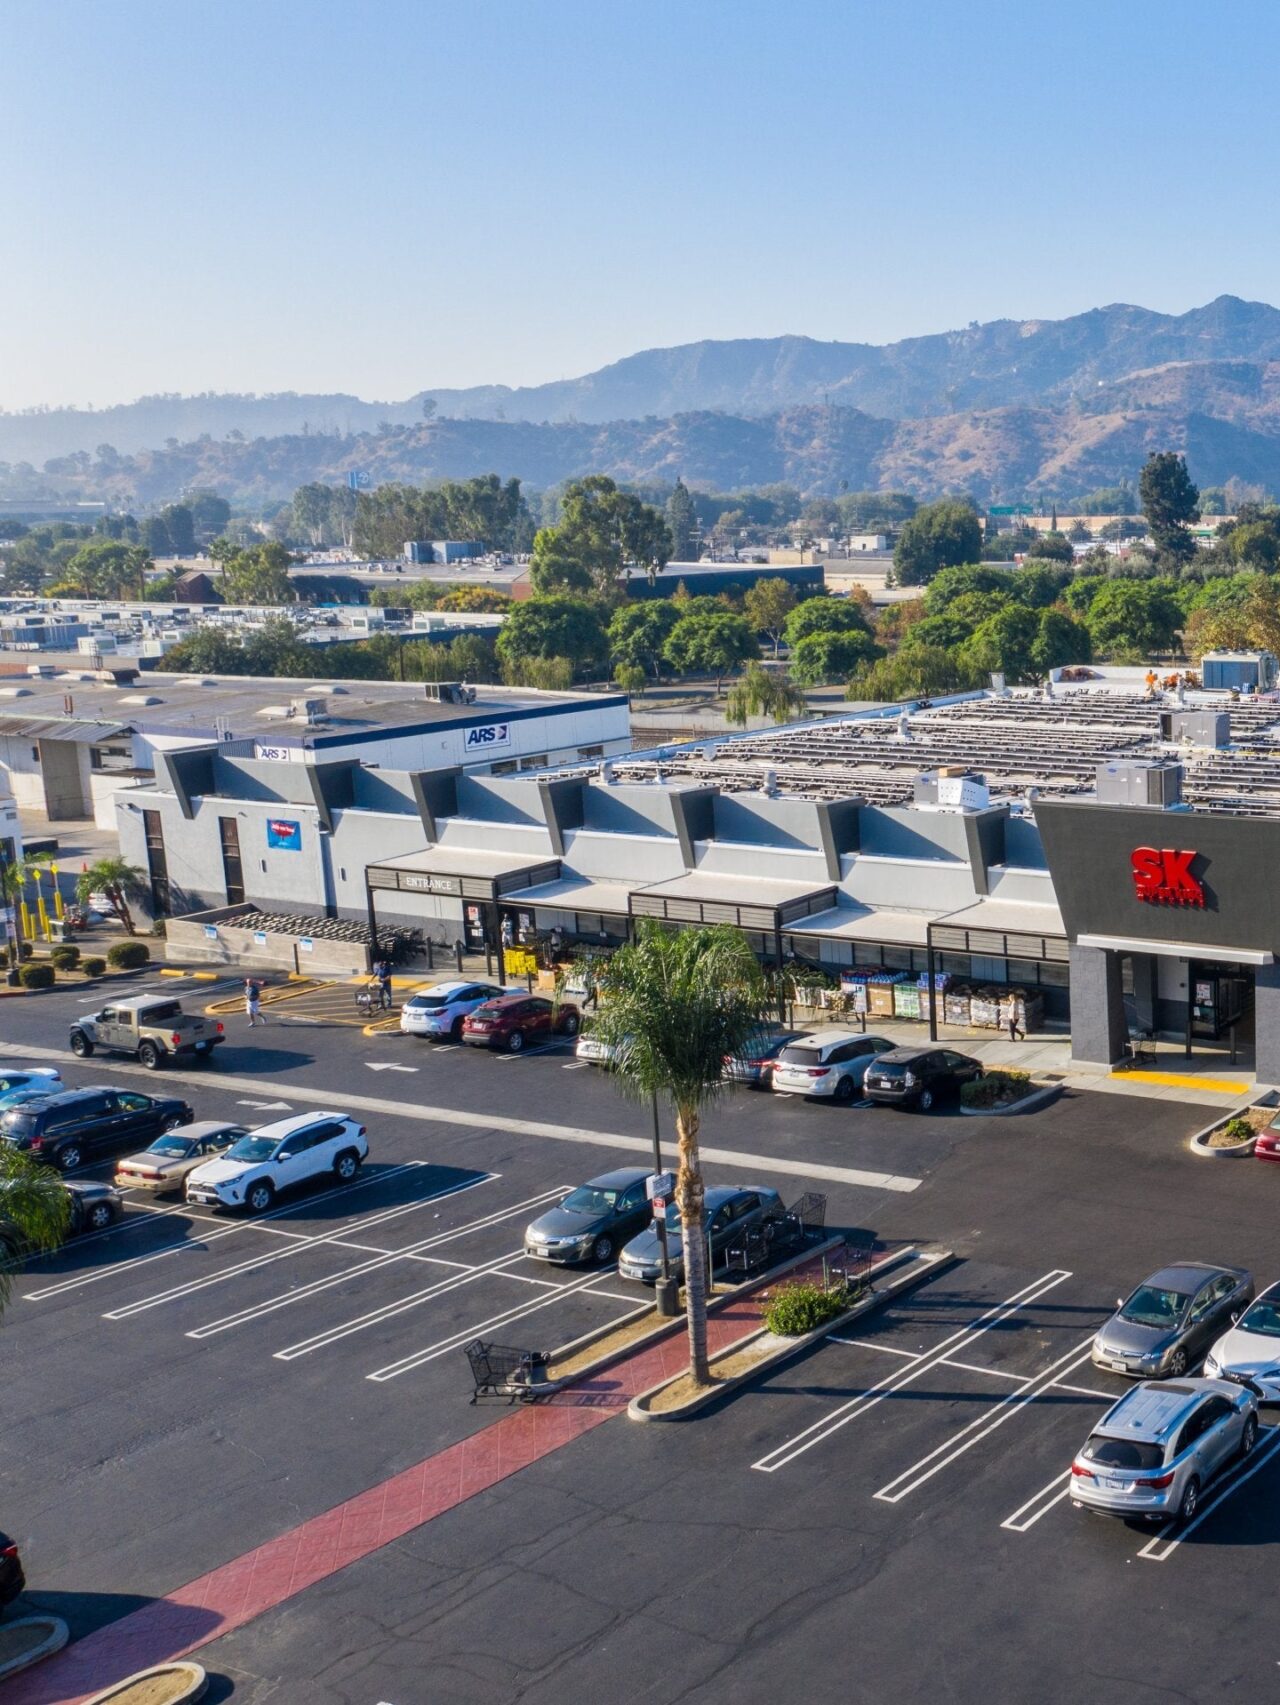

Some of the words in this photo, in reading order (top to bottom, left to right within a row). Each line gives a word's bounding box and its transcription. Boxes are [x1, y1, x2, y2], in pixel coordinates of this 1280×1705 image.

[468, 727, 496, 745] ARS
[261, 748, 280, 760] ARS
[1131, 847, 1198, 891] SK
[406, 876, 453, 891] ENTRANCE
